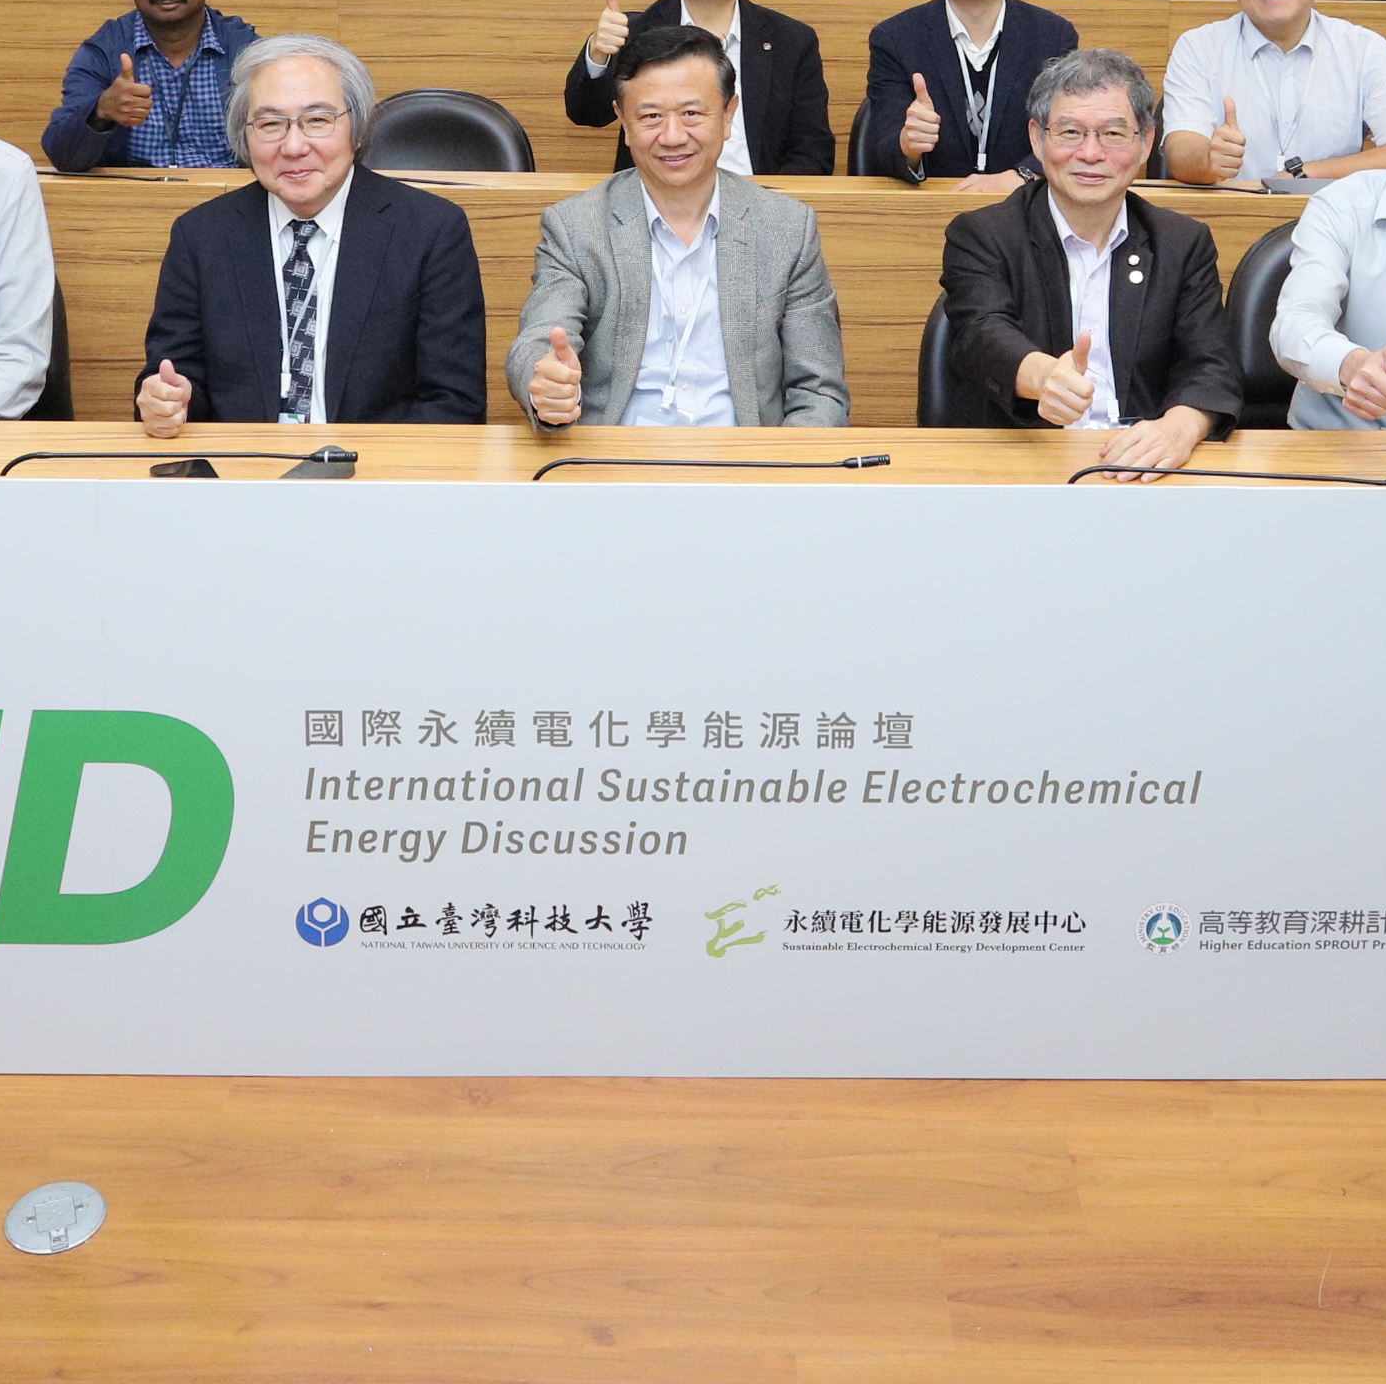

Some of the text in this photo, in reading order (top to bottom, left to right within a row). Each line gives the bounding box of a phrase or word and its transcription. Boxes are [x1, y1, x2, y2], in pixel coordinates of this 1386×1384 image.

[305, 709, 914, 749] 國際永續電化學能源論壇
[305, 767, 1202, 805] International Sustainable Electrochemical
[306, 820, 688, 863] Energy Discussion
[359, 901, 653, 941] 國立臺灣科技大學
[783, 909, 1087, 934] 永續電化學能源發展中心
[1138, 908, 1154, 943] MINISTRY
[1168, 905, 1190, 944] EDUCATION
[361, 941, 408, 949] NATIONAL
[448, 942, 501, 950] UNIVERSITY
[502, 942, 516, 950] OF
[517, 942, 557, 950] SCIENCE
[559, 942, 579, 950] AND
[582, 942, 647, 951] TECHNOLOGY
[782, 942, 1086, 953] Sustainable Electrochemical Energy Development Center
[1199, 939, 1243, 952] Higher
[1247, 939, 1311, 950] Education
[1314, 940, 1369, 950] SPROUT
